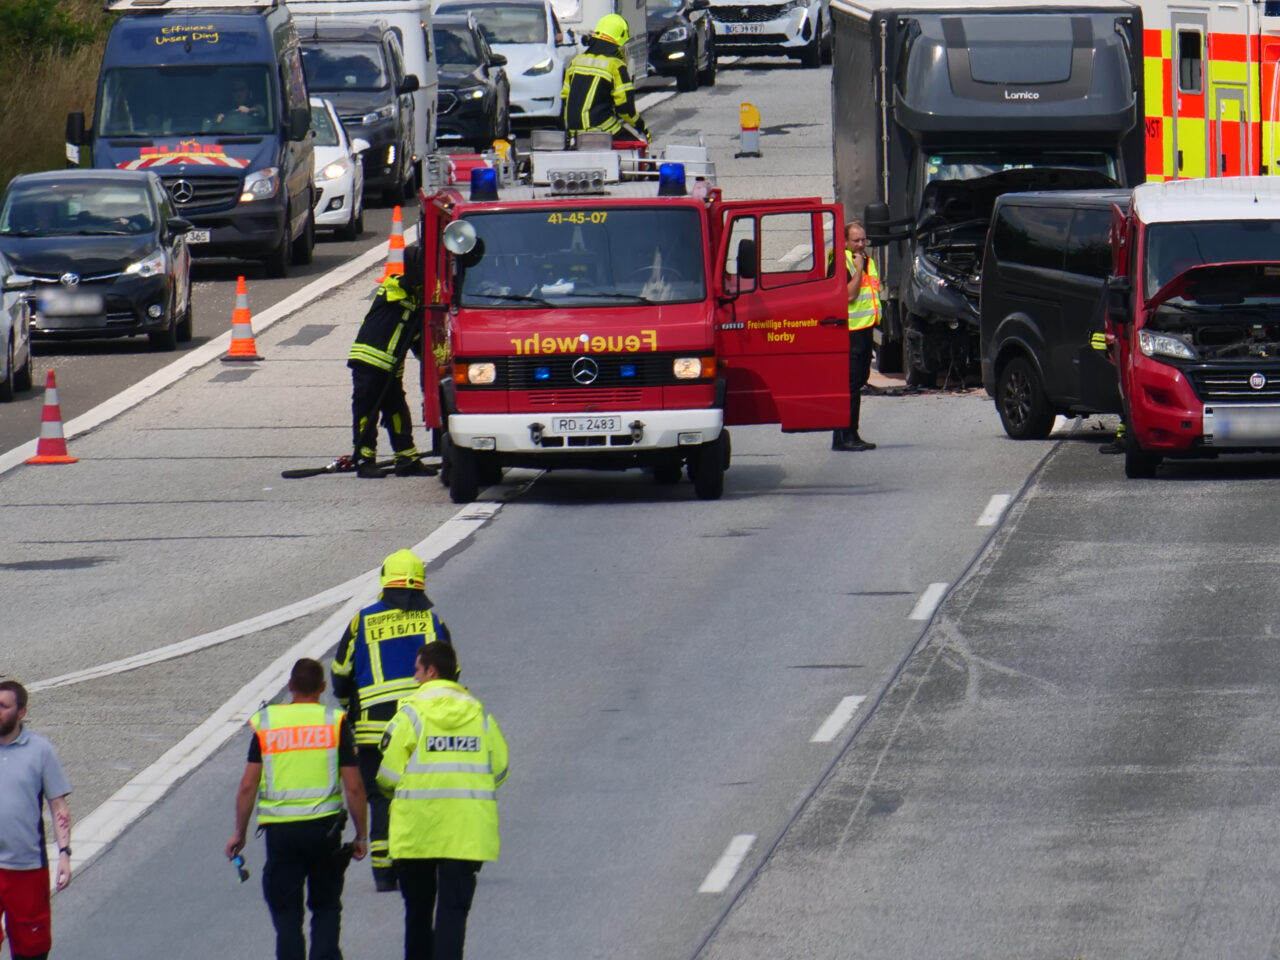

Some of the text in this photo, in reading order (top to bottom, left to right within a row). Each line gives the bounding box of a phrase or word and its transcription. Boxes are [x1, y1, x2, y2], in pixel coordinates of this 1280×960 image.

[155, 32, 219, 45] Unser Ding
[547, 212, 608, 224] 41-45-07
[783, 319, 818, 328] Feuerwehr
[767, 332, 795, 343] Norby
[559, 419, 615, 430] RD 2483
[370, 622, 427, 640] LF 16/12
[265, 726, 331, 751] POLIZEI
[426, 736, 481, 751] POLIZEI
